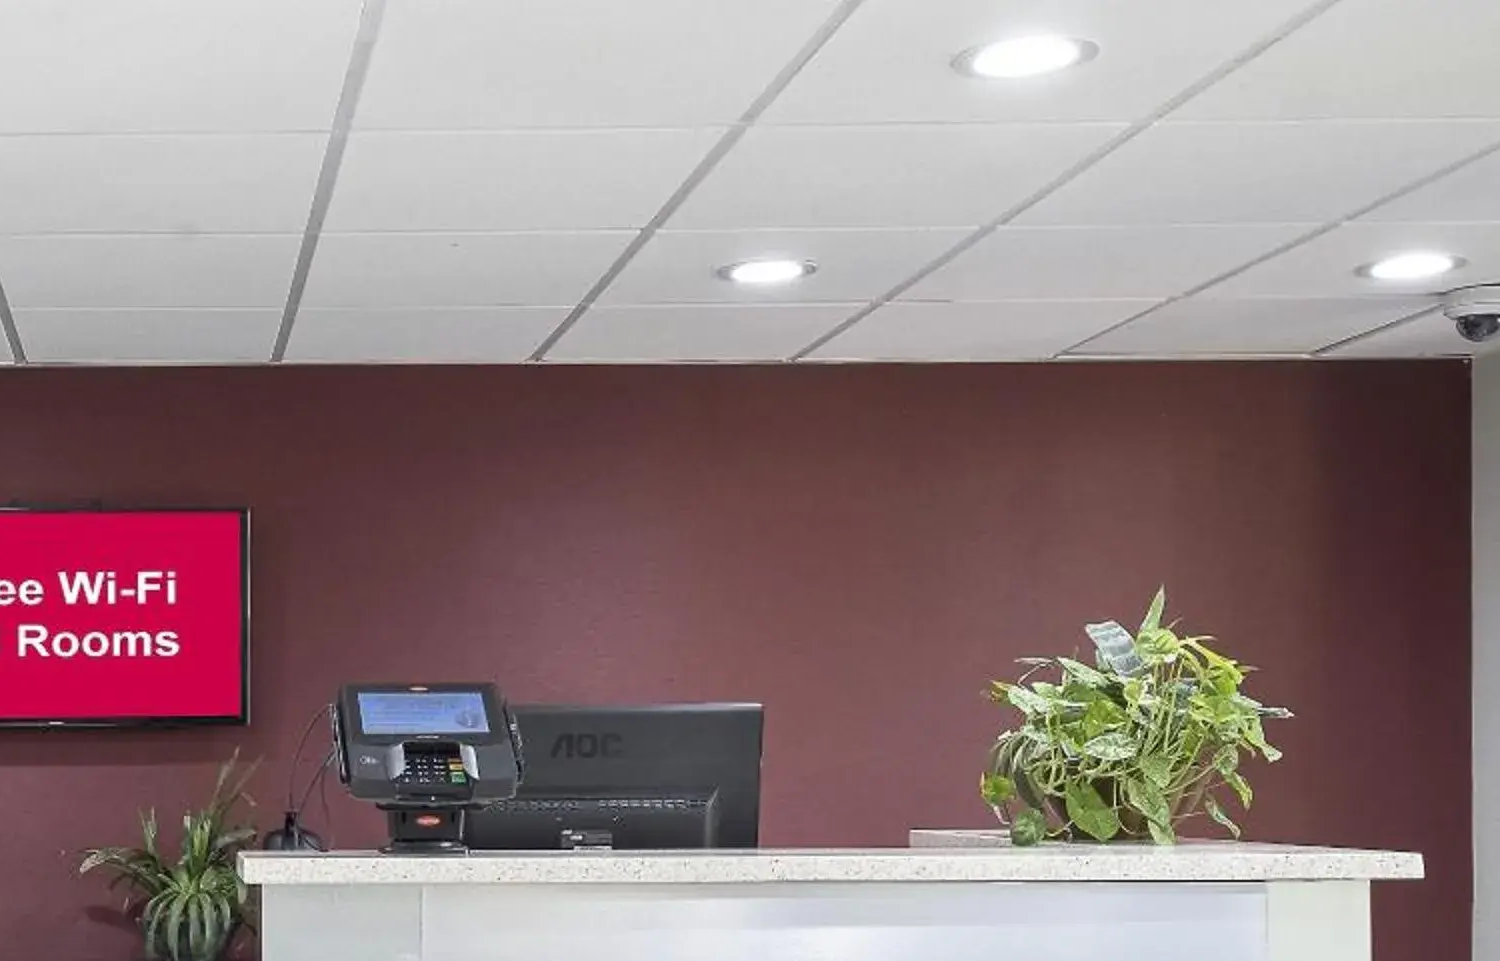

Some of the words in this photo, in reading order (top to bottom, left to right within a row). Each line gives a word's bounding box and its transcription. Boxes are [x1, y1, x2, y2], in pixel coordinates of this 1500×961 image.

[58, 571, 176, 605] Wi-Fi
[17, 624, 180, 658] Rooms
[550, 733, 625, 759] AOC
